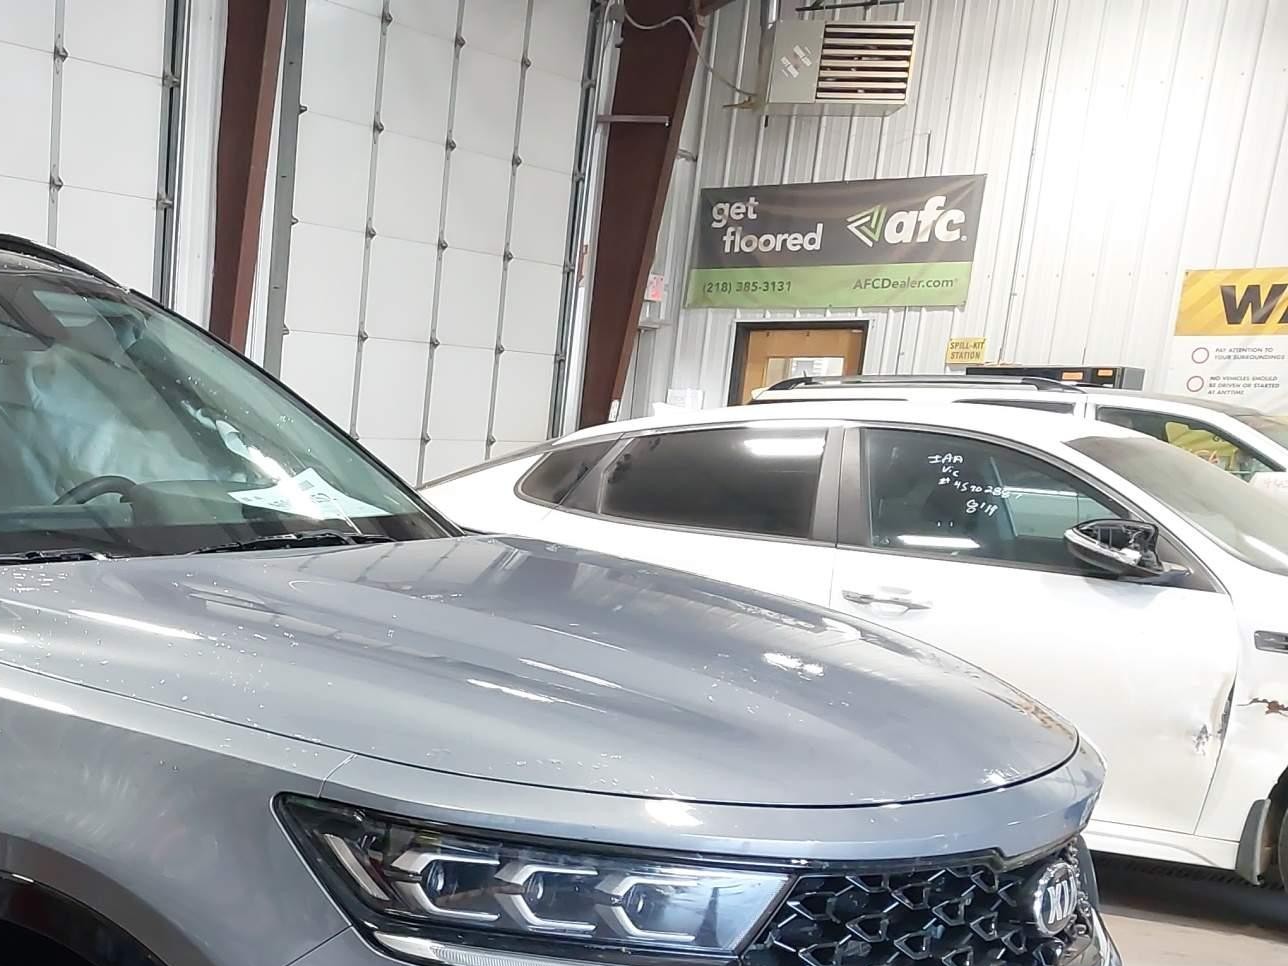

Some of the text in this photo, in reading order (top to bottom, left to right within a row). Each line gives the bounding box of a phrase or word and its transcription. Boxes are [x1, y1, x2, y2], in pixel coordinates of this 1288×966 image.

[712, 196, 759, 228] get
[722, 223, 824, 253] floored
[702, 280, 792, 294] (218) 385-3131
[951, 351, 981, 360] STATION
[928, 453, 964, 464] IAA
